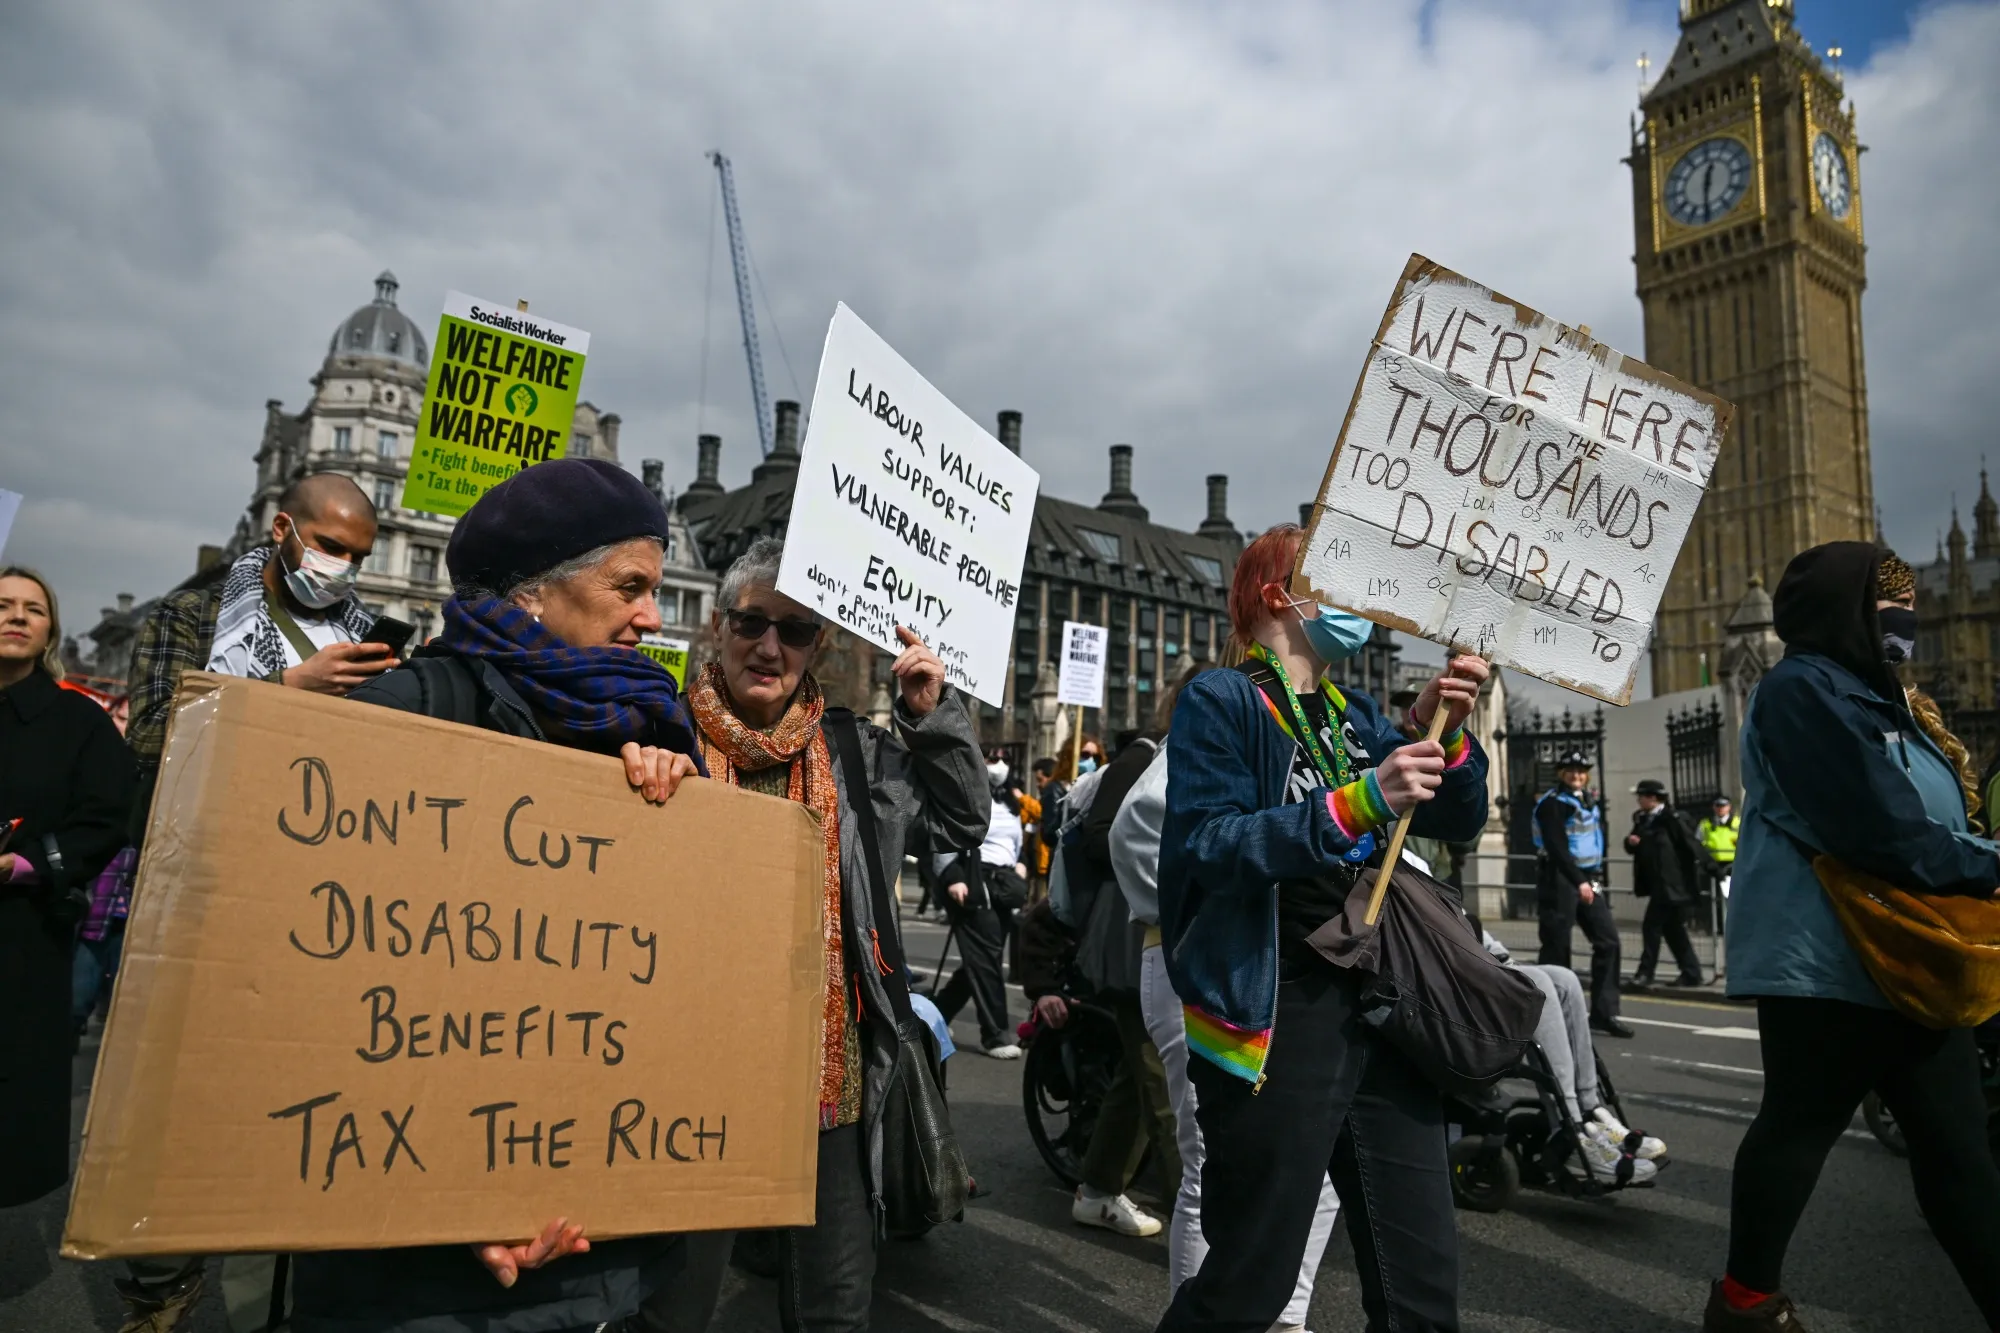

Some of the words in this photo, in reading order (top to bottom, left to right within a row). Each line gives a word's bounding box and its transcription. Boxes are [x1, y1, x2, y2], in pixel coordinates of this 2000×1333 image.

[446, 323, 574, 391] WELFARE
[470, 306, 523, 334] Socialist
[524, 321, 566, 346] Worker
[436, 363, 500, 410] NOT
[1409, 294, 1561, 401] WE'RE
[1578, 369, 1708, 473] HERE
[429, 402, 561, 461] WARFARE
[848, 368, 926, 457] LABOUR
[940, 443, 1013, 514] VALUES
[1480, 396, 1535, 431] FOR
[1566, 431, 1606, 461] THE
[428, 470, 451, 491] Tax
[455, 477, 478, 496] the
[431, 447, 467, 471] Fight
[471, 456, 522, 479] benefit
[1348, 443, 1411, 491] TOO
[1387, 375, 1670, 551] THOUSANDS
[831, 463, 952, 566] VULNERABLE
[1323, 538, 1351, 560] AA
[1391, 491, 1623, 625] DISABLED
[807, 564, 850, 597] don't
[853, 594, 899, 628] punish
[864, 554, 953, 628] EQUITY
[1368, 577, 1400, 598] LMS
[837, 603, 888, 643] enrich
[1534, 627, 1557, 646] MM
[1591, 630, 1622, 663] TO
[503, 794, 616, 876] CUT
[356, 984, 628, 1066] BENEFITS
[267, 1091, 427, 1191] TAX
[469, 1100, 577, 1171] THE
[605, 1097, 727, 1168] RICH
